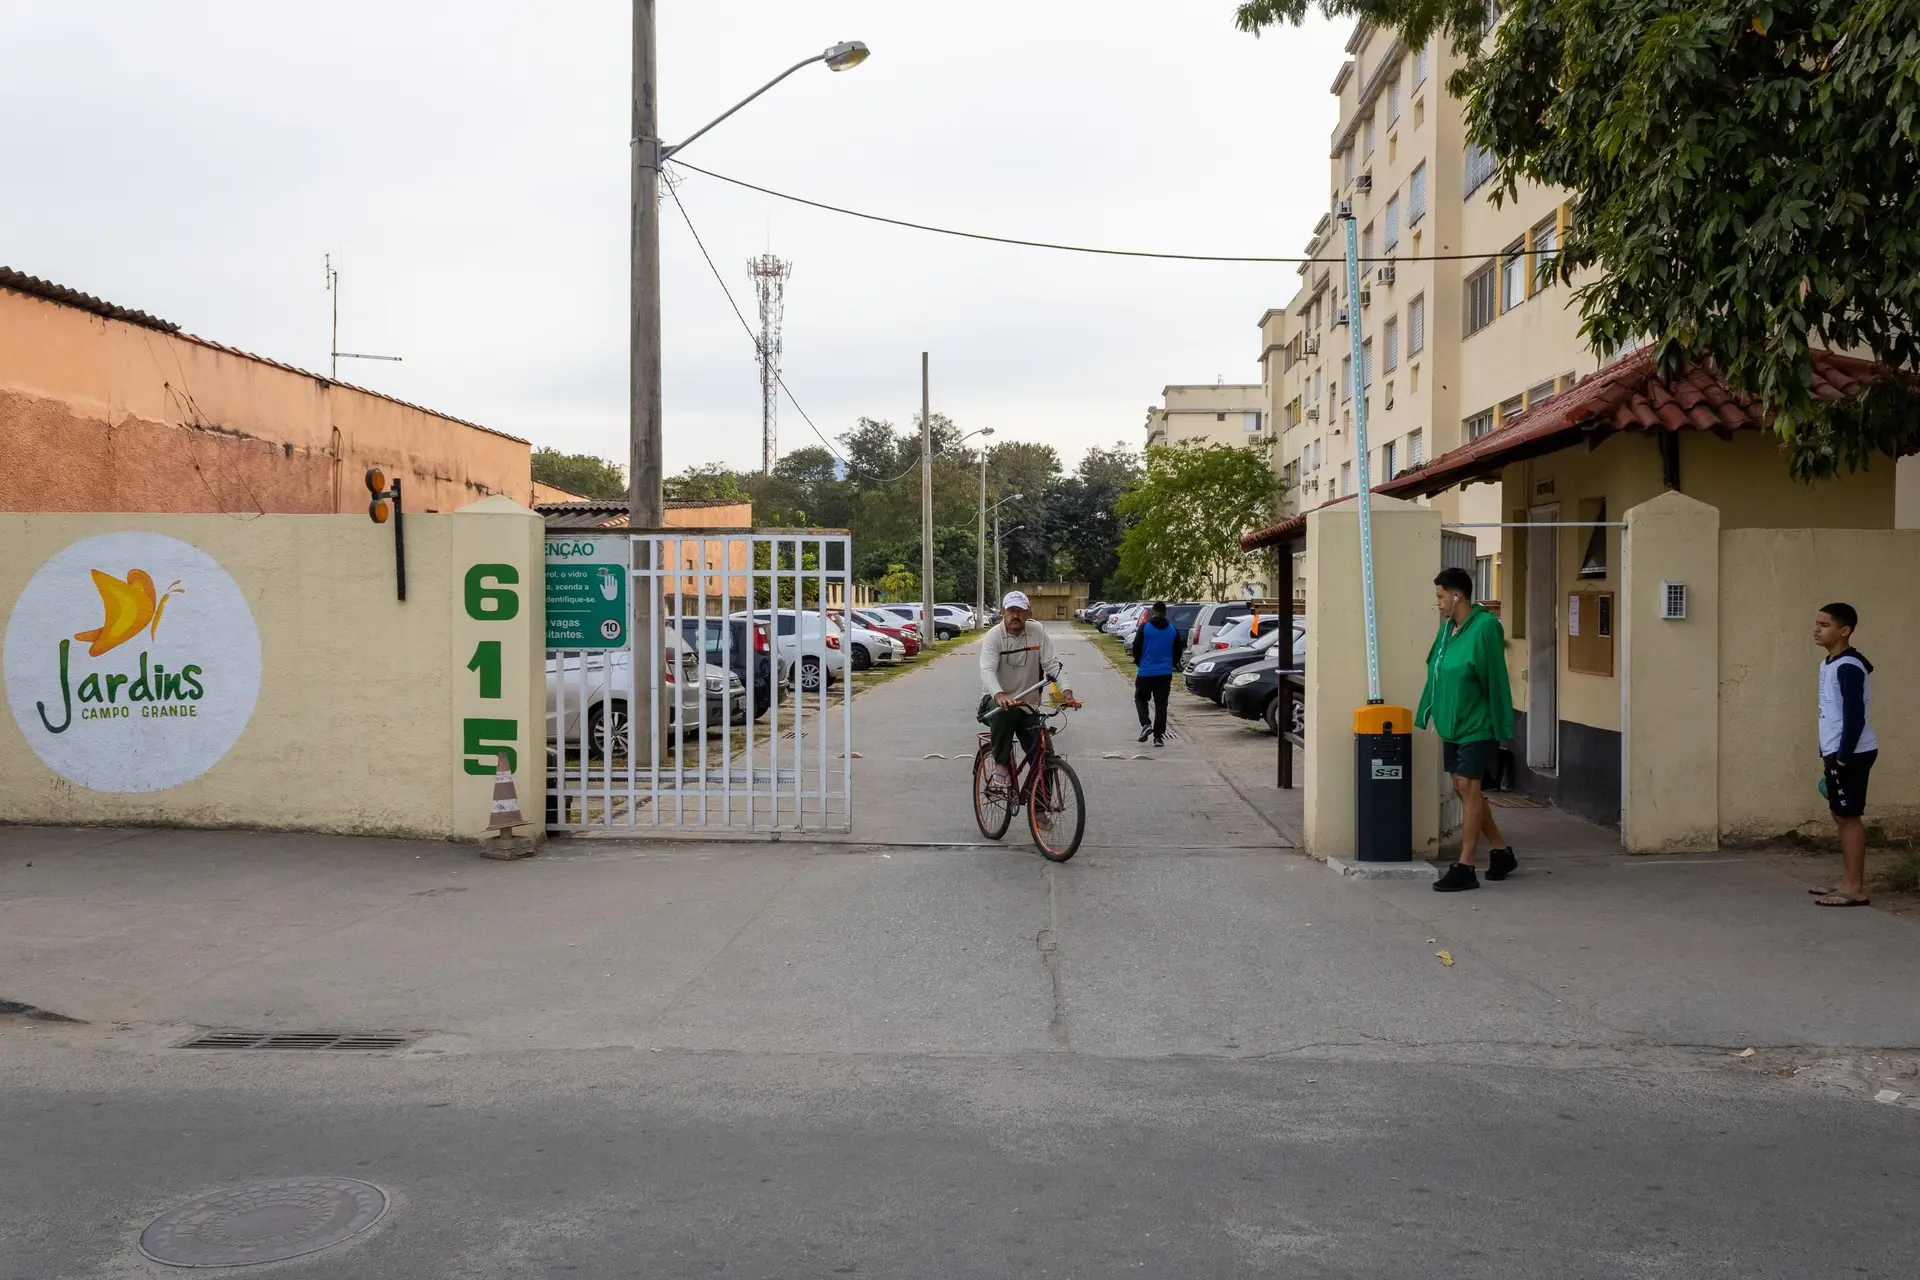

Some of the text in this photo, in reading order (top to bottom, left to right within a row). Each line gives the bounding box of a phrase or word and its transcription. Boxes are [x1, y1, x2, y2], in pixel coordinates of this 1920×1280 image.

[550, 619, 580, 628] vagas
[603, 622, 618, 632] 10
[545, 630, 584, 639] itantes.
[463, 563, 520, 775] 615
[36, 639, 204, 734] Jardins
[81, 705, 198, 721] CAMPO GRANDE
[1830, 769, 1847, 806] NIKE
